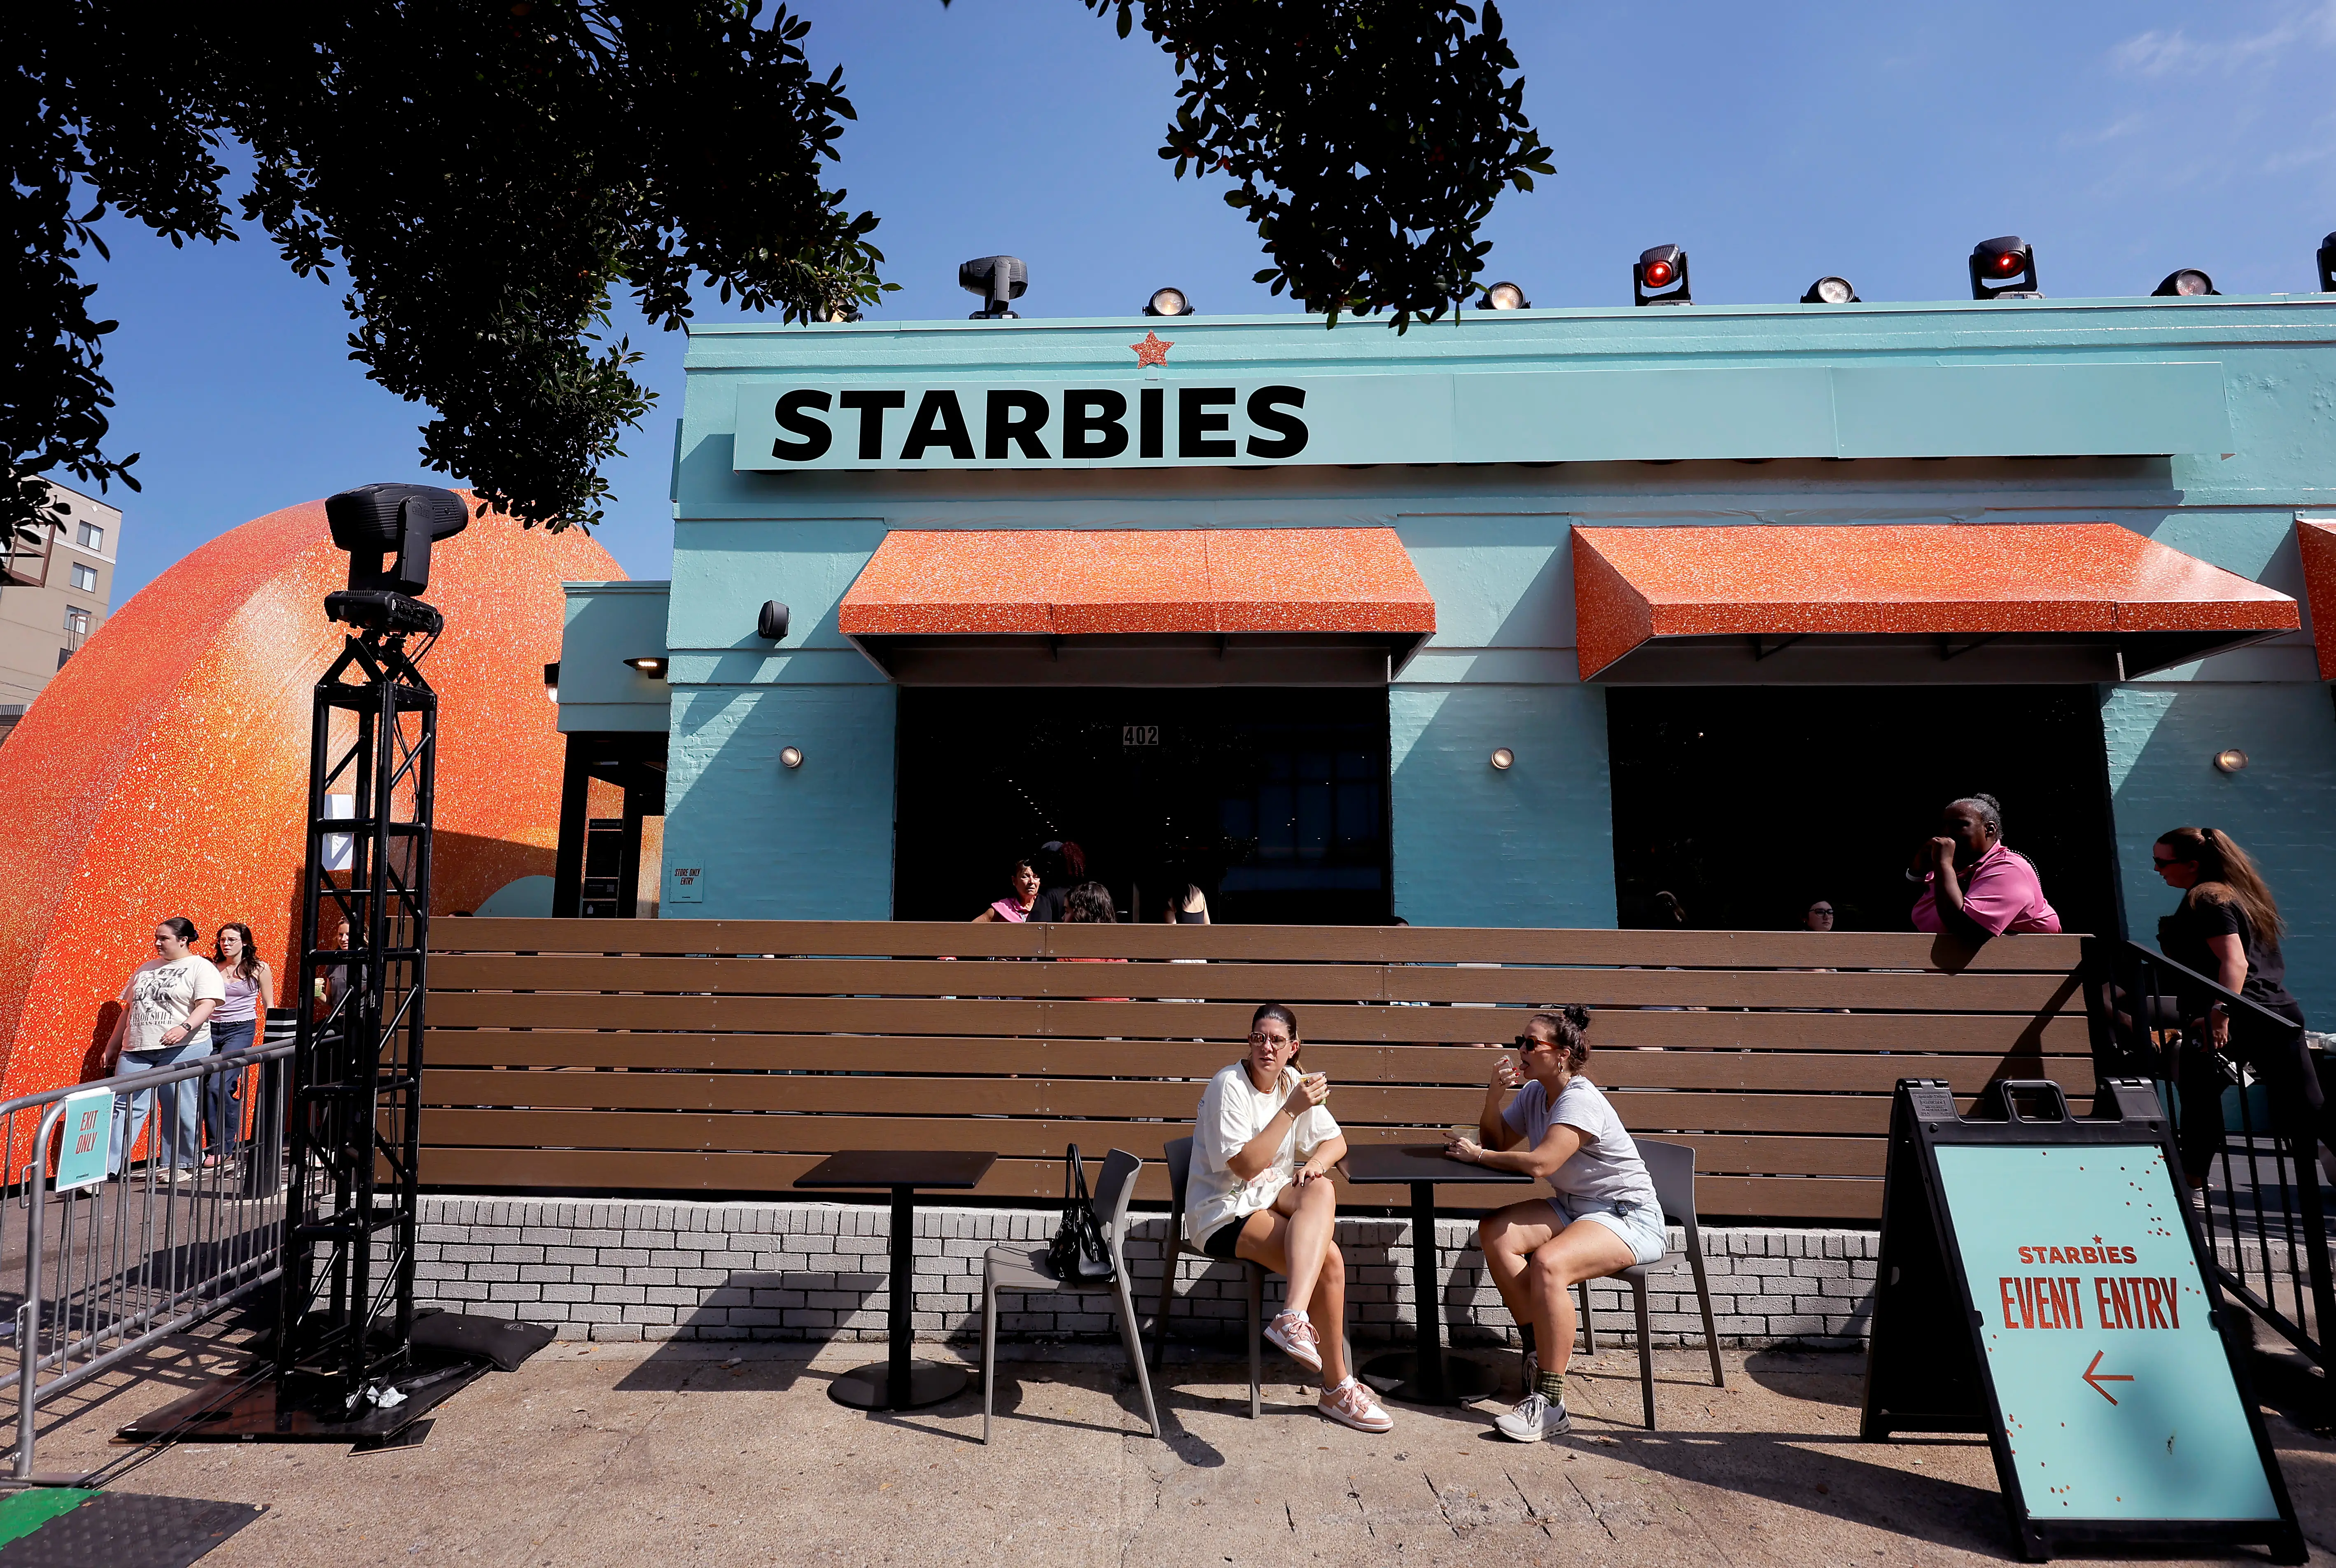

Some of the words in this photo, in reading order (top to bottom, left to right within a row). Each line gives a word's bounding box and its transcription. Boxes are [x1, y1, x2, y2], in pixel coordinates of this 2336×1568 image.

[771, 385, 1309, 462] STARBIES
[1124, 726, 1157, 744] 402
[80, 1110, 98, 1132] EXIT
[75, 1132, 98, 1155] ONLY
[2018, 1246, 2138, 1264] STARBIES
[1999, 1277, 2083, 1329] EVENT
[2094, 1277, 2180, 1329] ENTRY
